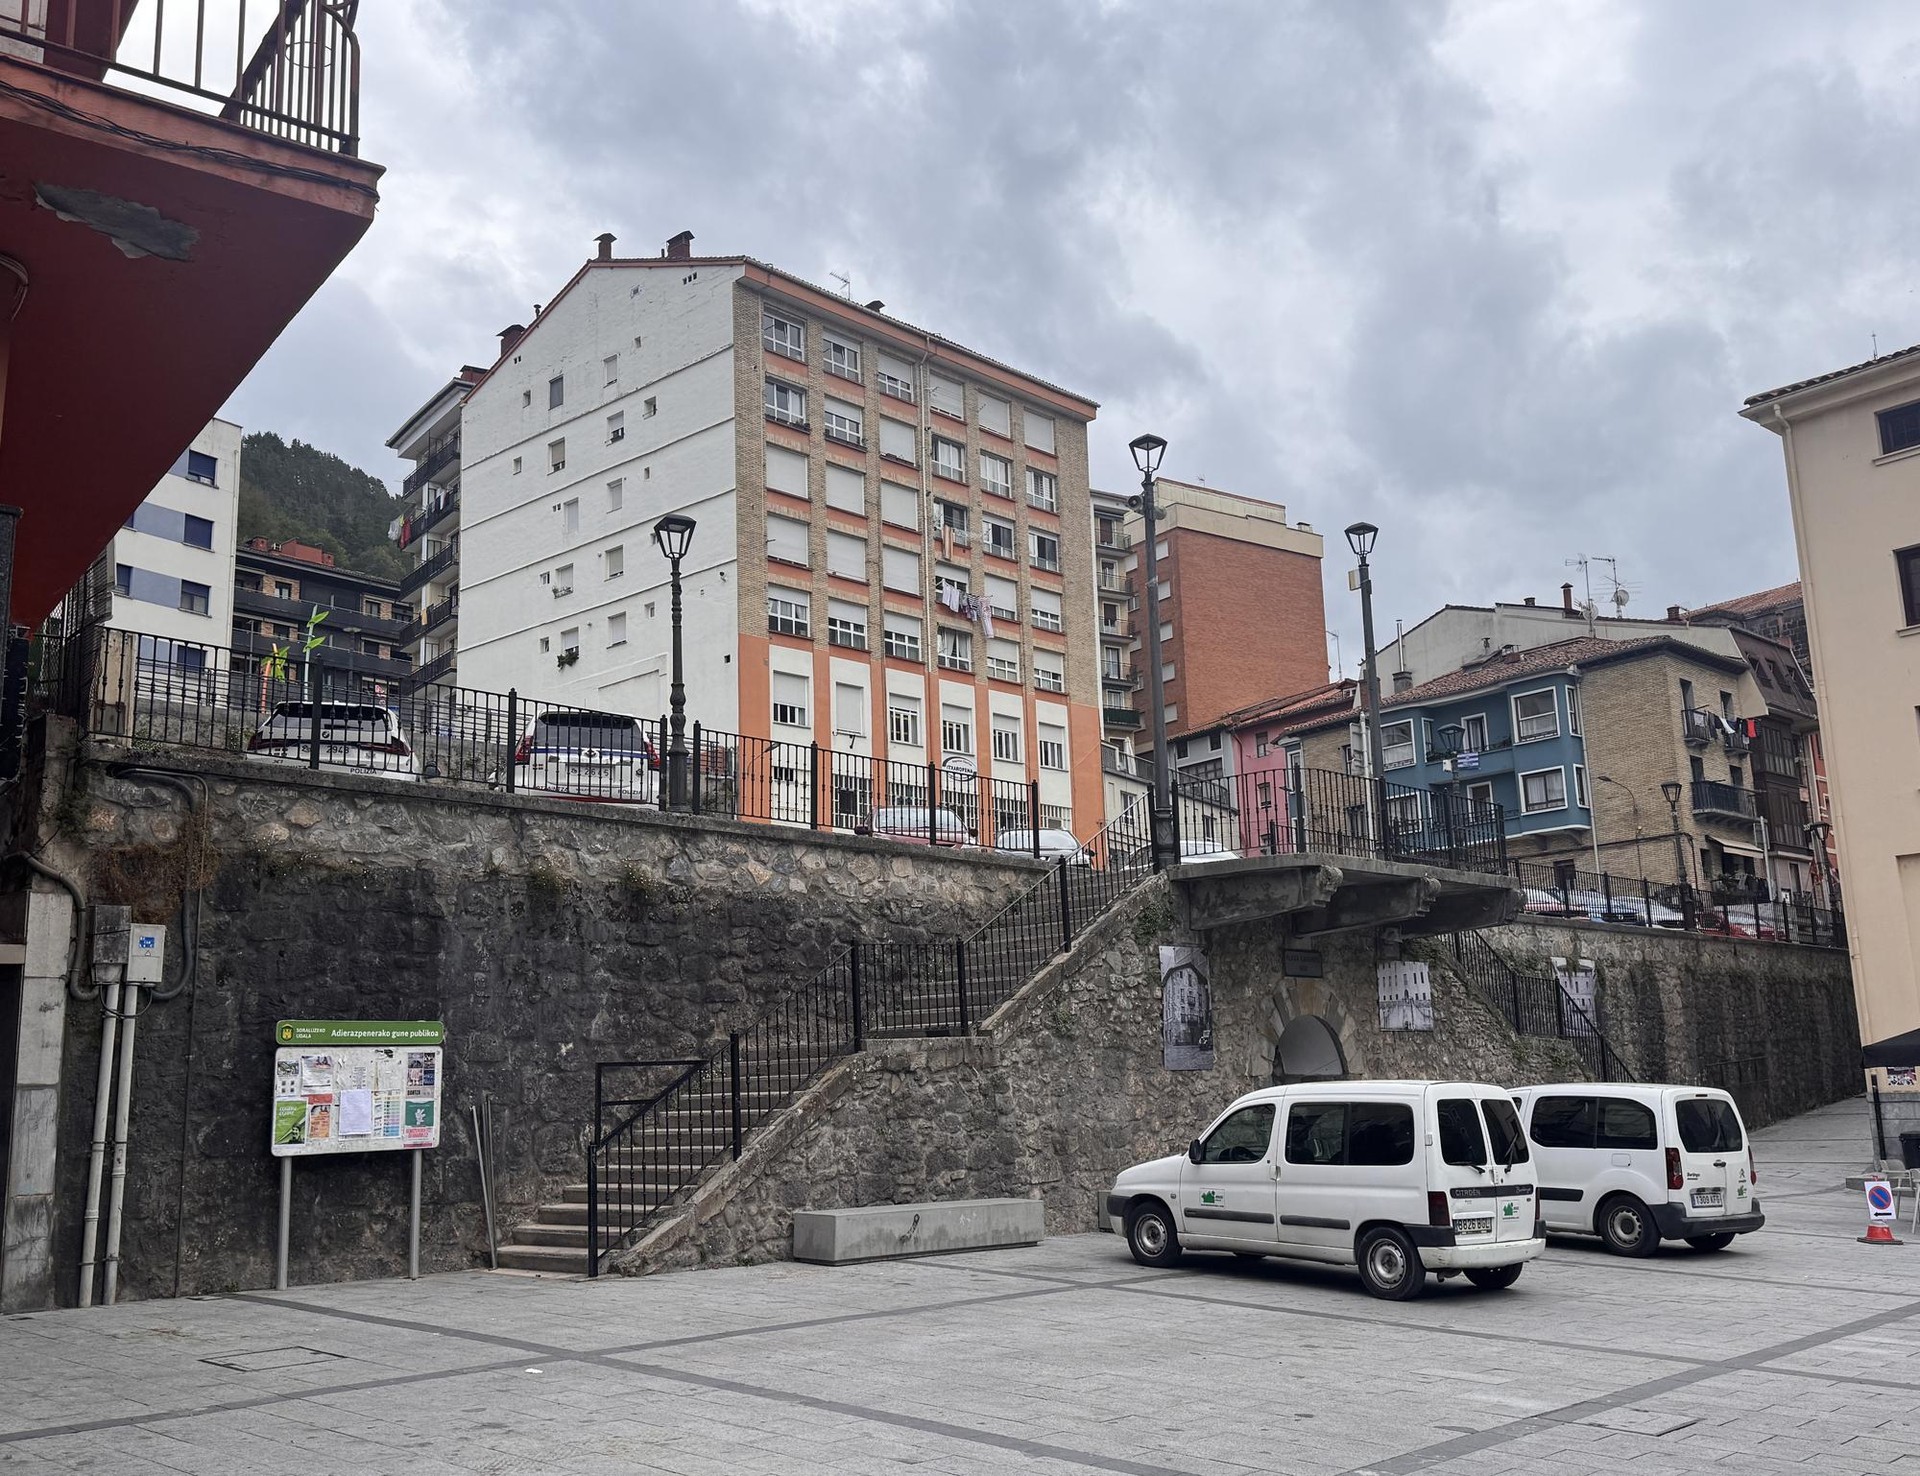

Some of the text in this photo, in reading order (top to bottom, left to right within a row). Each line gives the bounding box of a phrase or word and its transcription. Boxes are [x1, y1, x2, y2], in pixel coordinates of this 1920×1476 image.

[350, 767, 377, 775] POLIZIA
[331, 1029, 439, 1039] Adierazpenerako gune publikoa
[1458, 1219, 1476, 1231] 8826
